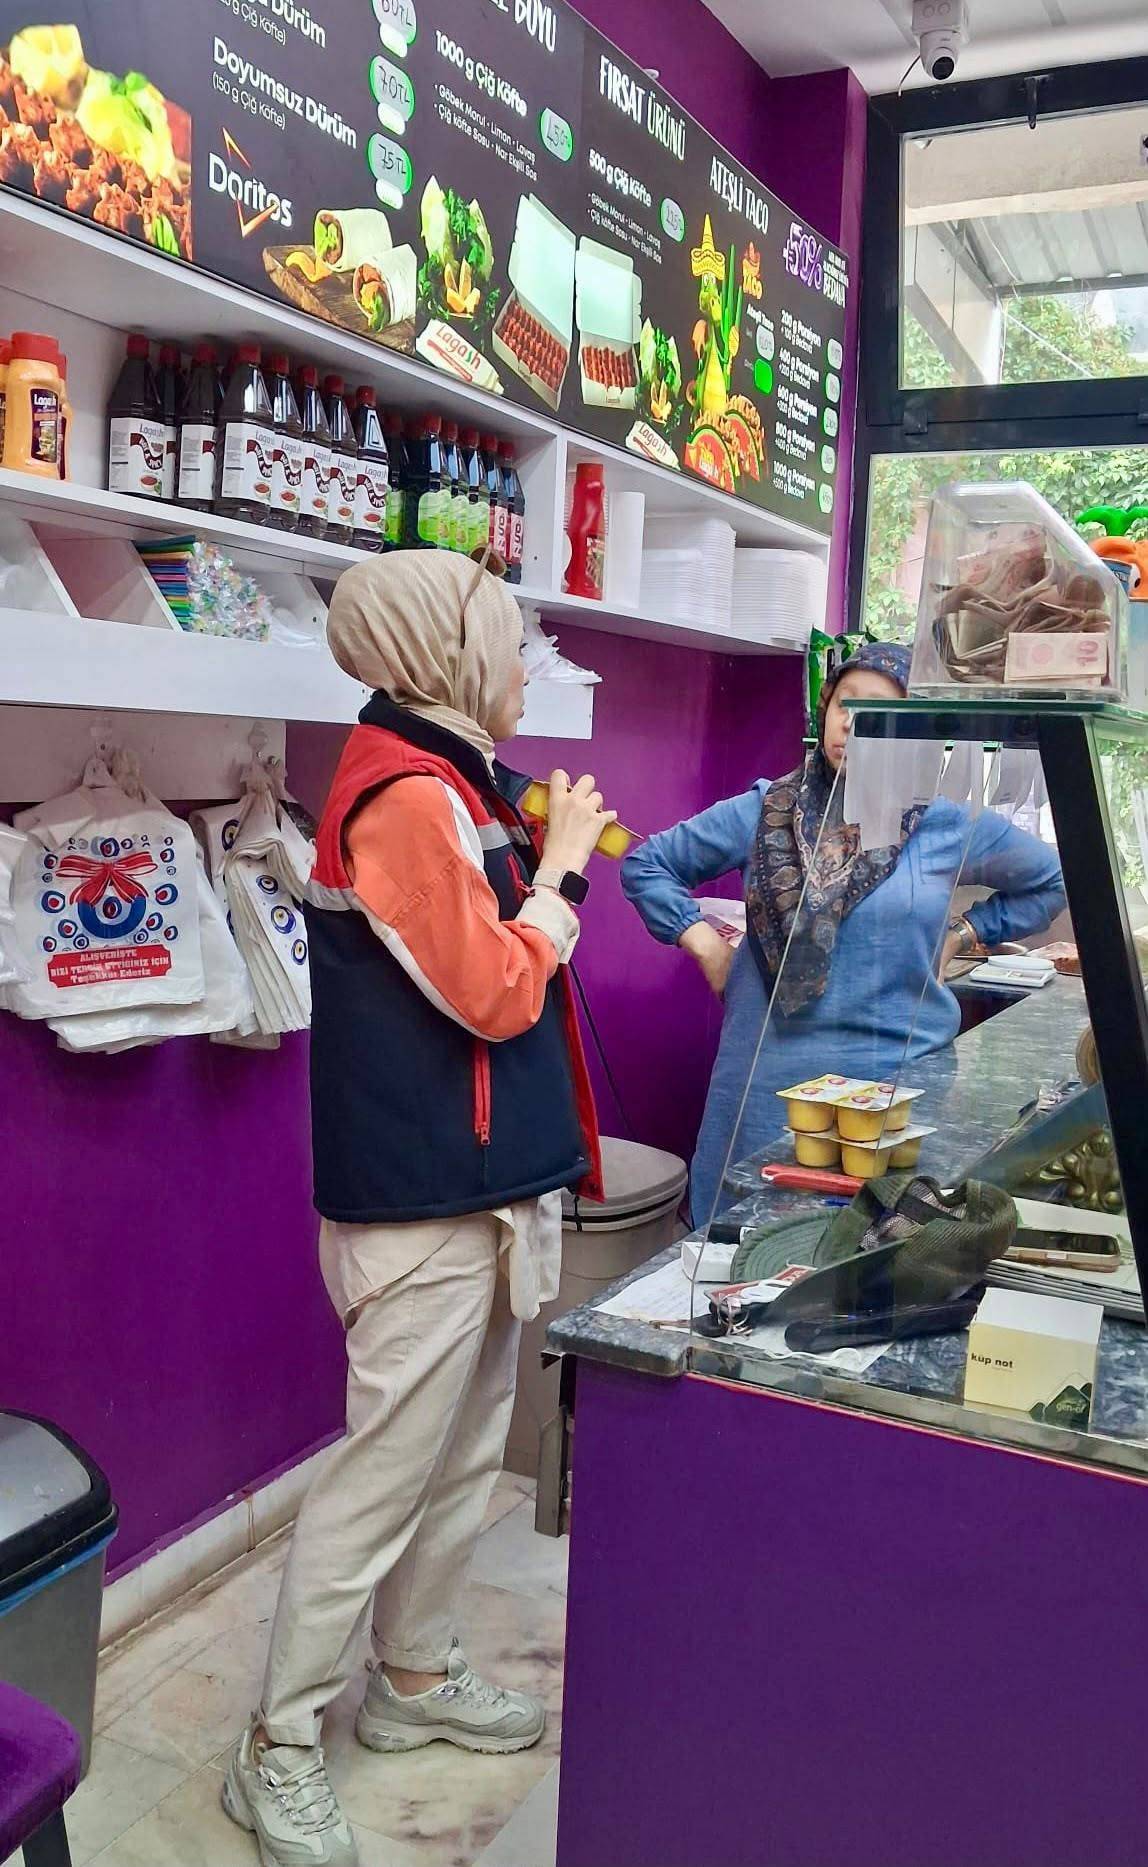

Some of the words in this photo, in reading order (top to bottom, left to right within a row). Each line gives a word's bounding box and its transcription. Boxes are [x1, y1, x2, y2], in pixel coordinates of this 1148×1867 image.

[241, 3, 258, 28] Çiğ
[271, 0, 326, 48] Dürüm
[212, 71, 230, 96] (150
[231, 86, 239, 104] g
[240, 91, 258, 115] Çiğ
[259, 101, 287, 131] Köfte)
[213, 36, 304, 117] Doyumsuz
[305, 97, 357, 150] Dürüm
[436, 30, 464, 68] 1000
[465, 57, 474, 81] g
[475, 62, 496, 97] Çiğ
[497, 77, 528, 117] Köfte
[439, 84, 465, 112] Göbek
[490, 121, 512, 145] Limon
[599, 54, 646, 125] FIRSAT
[646, 90, 686, 161] ÜRÜNÜ
[472, 127, 491, 150] Sosu
[495, 143, 509, 162] Nar
[208, 152, 293, 228] Doritos
[589, 148, 606, 175] 500
[606, 164, 614, 185] g
[629, 176, 652, 208] Köfte
[709, 155, 744, 213] ATEŞLİ
[745, 186, 769, 236] TACO
[435, 325, 482, 371] Lagash
[638, 422, 668, 457] Lagash
[994, 1358, 1013, 1369] not
